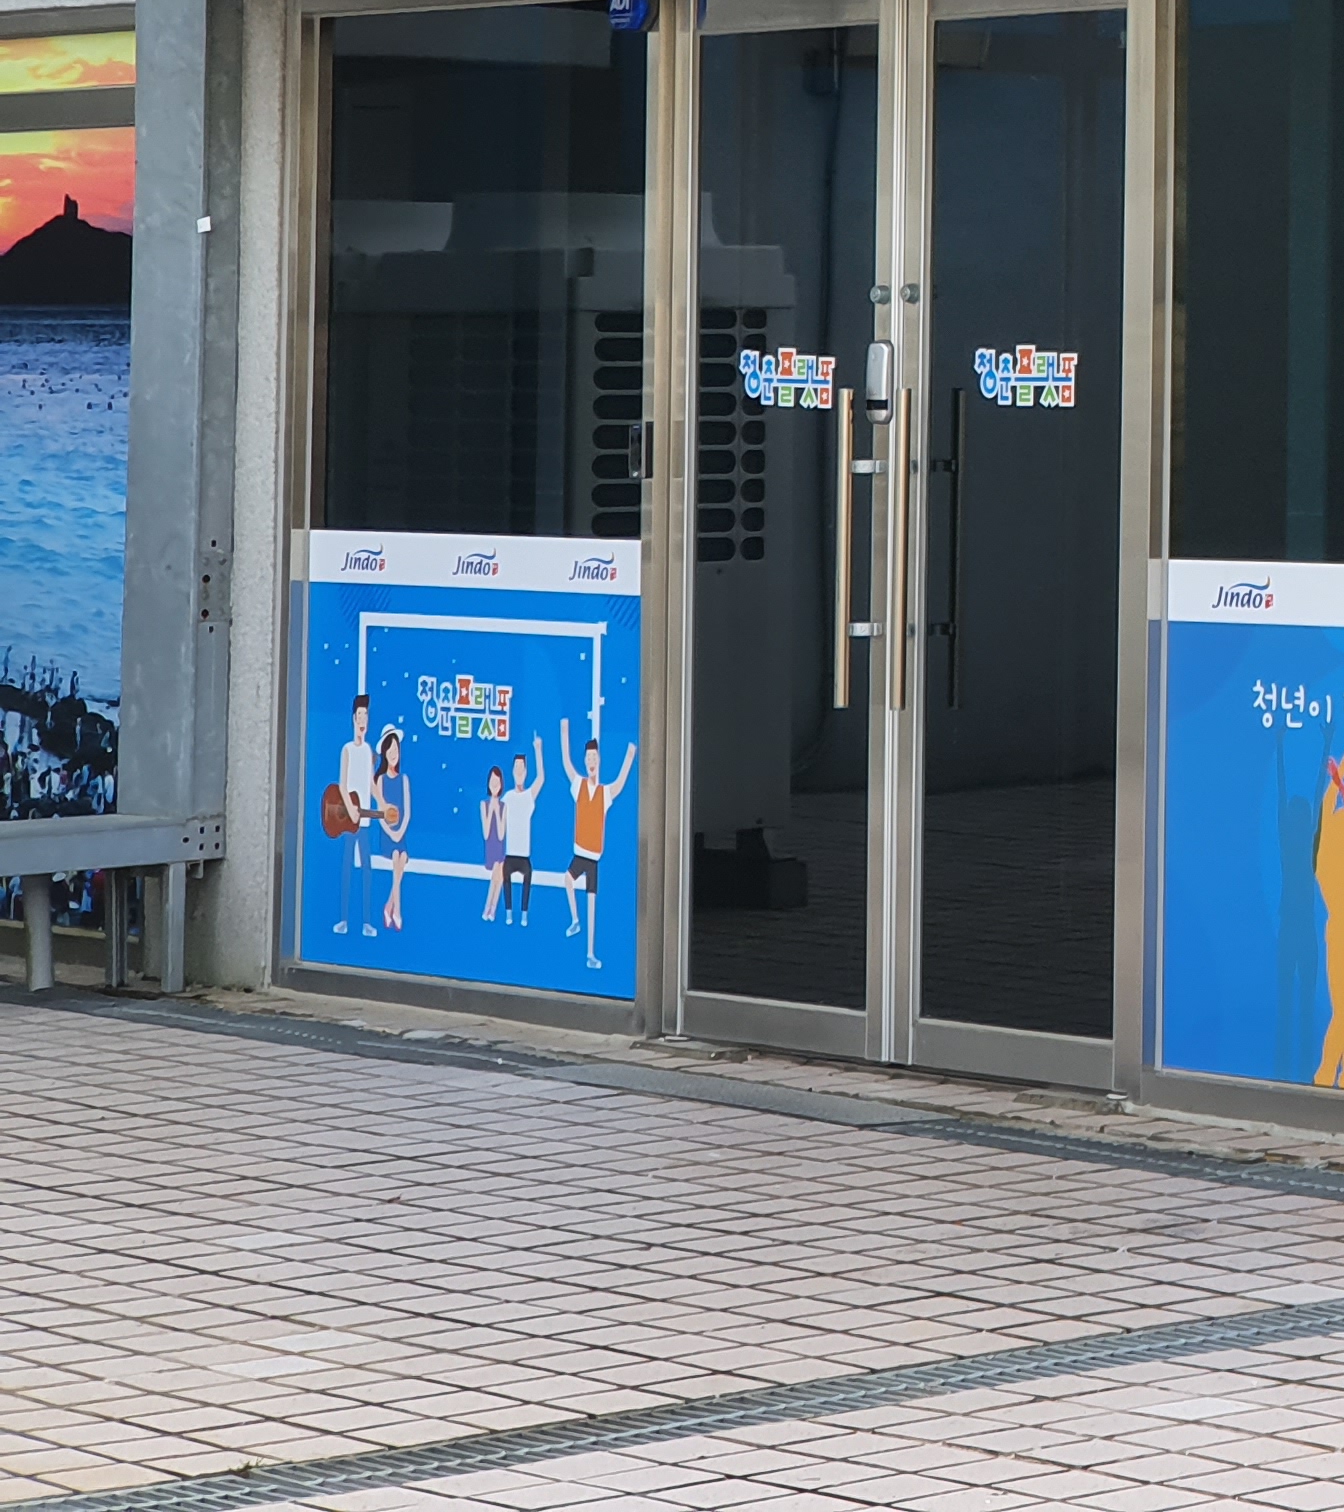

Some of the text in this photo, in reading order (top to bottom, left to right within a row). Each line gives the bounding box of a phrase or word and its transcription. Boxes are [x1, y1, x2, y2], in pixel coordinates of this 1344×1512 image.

[341, 551, 378, 572] Jindo
[452, 555, 491, 576] Jindo
[568, 560, 610, 581] Jindo
[1211, 585, 1264, 609] Jindo
[1251, 678, 1333, 729] 청년이
